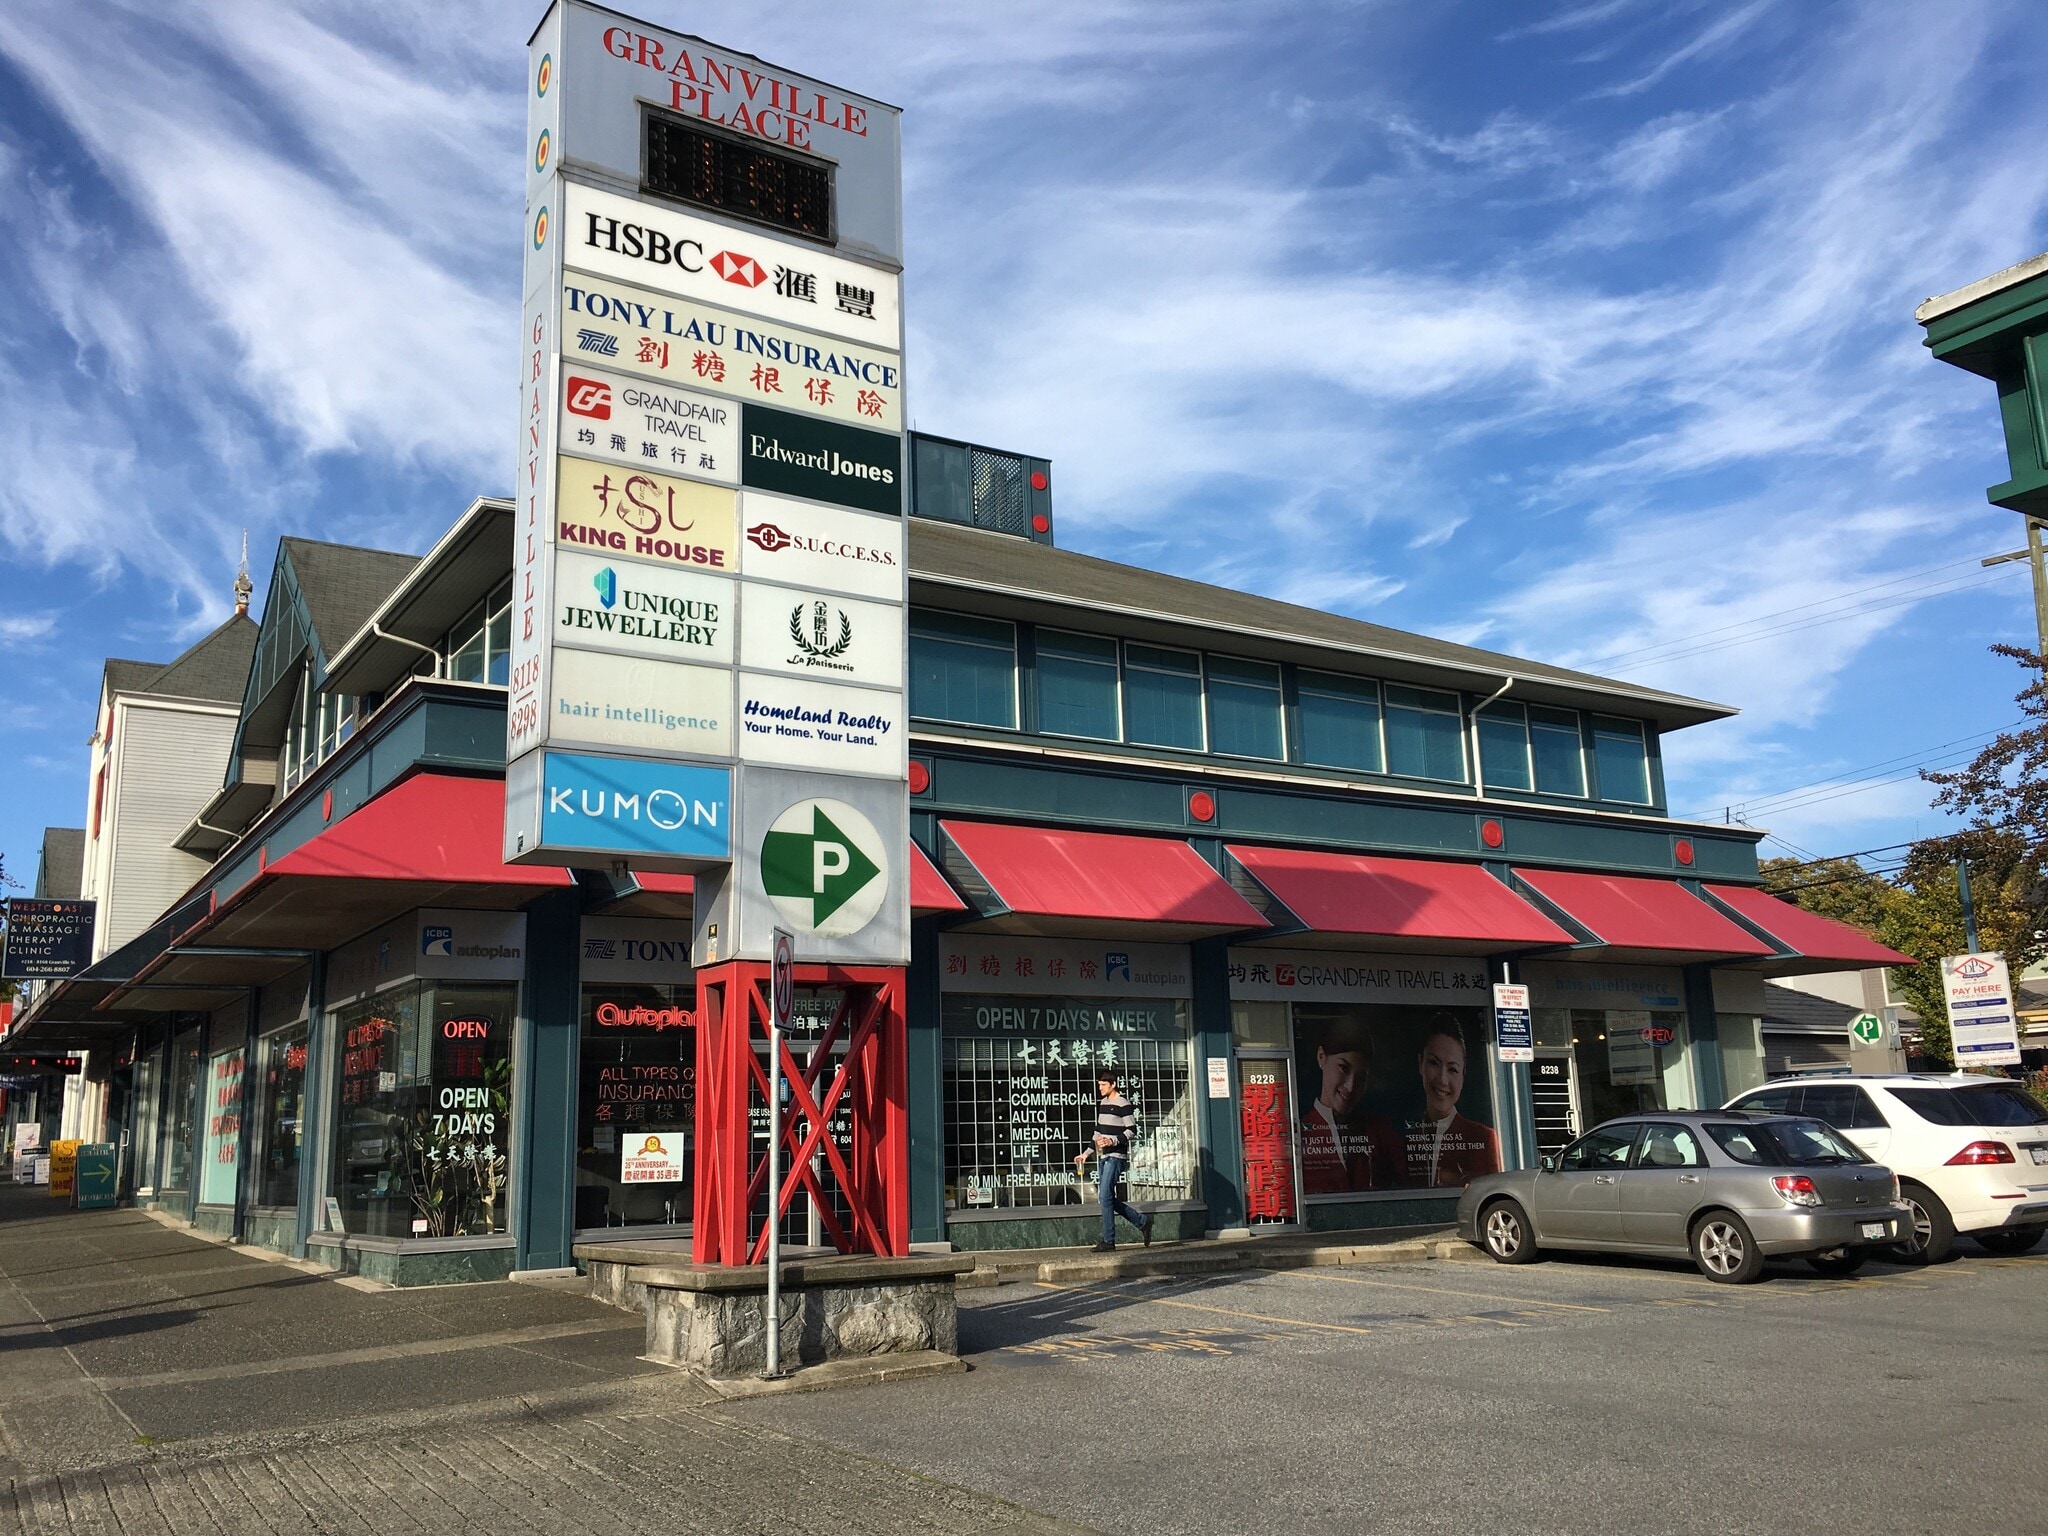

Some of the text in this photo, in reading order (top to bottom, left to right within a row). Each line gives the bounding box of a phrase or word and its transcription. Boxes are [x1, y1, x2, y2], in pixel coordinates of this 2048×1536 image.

[603, 27, 867, 137] GRANVILLE
[668, 78, 811, 151] PLACE
[585, 212, 703, 273] HSBC
[564, 286, 899, 389] TONY LAU INSURANCE
[622, 389, 728, 426] GRANDFAIR
[645, 414, 707, 444] TRAVEL
[577, 429, 717, 471] 均飛旅行社
[522, 312, 543, 643] GRANVILLE
[560, 522, 725, 568] KING HOUSE
[793, 534, 897, 567] S.U.C.C.E.S.S.
[623, 590, 719, 623] UNIQUE
[561, 606, 718, 647] JEWELLERY
[786, 653, 855, 673] La Patisserie
[513, 655, 540, 696] 8118
[510, 700, 538, 741] 8298
[559, 698, 718, 731] hair intelligence
[837, 711, 891, 734] Realty
[744, 721, 878, 747] Your Home. Your Land.
[550, 786, 718, 830] KUMON
[813, 840, 850, 894] P
[13, 904, 82, 912] WESTCOAST
[11, 914, 92, 924] CHIROPRACTIC
[10, 925, 80, 934] & MASSAGE
[426, 928, 449, 938] ICBC
[10, 936, 62, 944] THERAPY
[8, 946, 52, 955] CLINIC
[456, 944, 521, 960] autoplan
[622, 940, 693, 962] TONY
[1107, 955, 1127, 965] ICBC
[1134, 971, 1186, 986] autoplan
[1297, 966, 1450, 990] GRANDFAIR TRAVEL
[1952, 984, 2002, 996] PAY HERE
[794, 999, 821, 1012] FREE
[976, 1007, 1158, 1032] OPEN 7 DAYS A WEEK
[443, 1021, 488, 1039] OPEN
[1641, 1028, 1674, 1041] OPEN
[1860, 1021, 1874, 1037] P
[600, 1066, 697, 1081] ALL TYPES O
[1541, 1066, 1559, 1074] 8238
[1011, 1077, 1049, 1089] HOME
[1250, 1074, 1275, 1084] 8228
[440, 1087, 489, 1109] OPEN
[599, 1083, 697, 1100] INSURANC
[1011, 1093, 1097, 1106] COMMERCIAL
[433, 1113, 495, 1135] 7 DAYS
[1012, 1110, 1047, 1123] AUTO
[1012, 1128, 1069, 1141] MEDICAL
[1309, 1136, 1324, 1145] JUST
[1341, 1135, 1348, 1143] IT
[1349, 1135, 1369, 1143] WHEN
[1455, 1133, 1463, 1141] AS
[1013, 1145, 1040, 1158] LIFE
[1307, 1146, 1321, 1155] CAN
[1407, 1143, 1416, 1151] MY
[1456, 1142, 1467, 1150] SEE
[1468, 1142, 1485, 1150] THEM
[635, 1161, 668, 1169] ANNIVERSARY
[967, 1172, 1075, 1188] 30 MIN. FREE PARKING
